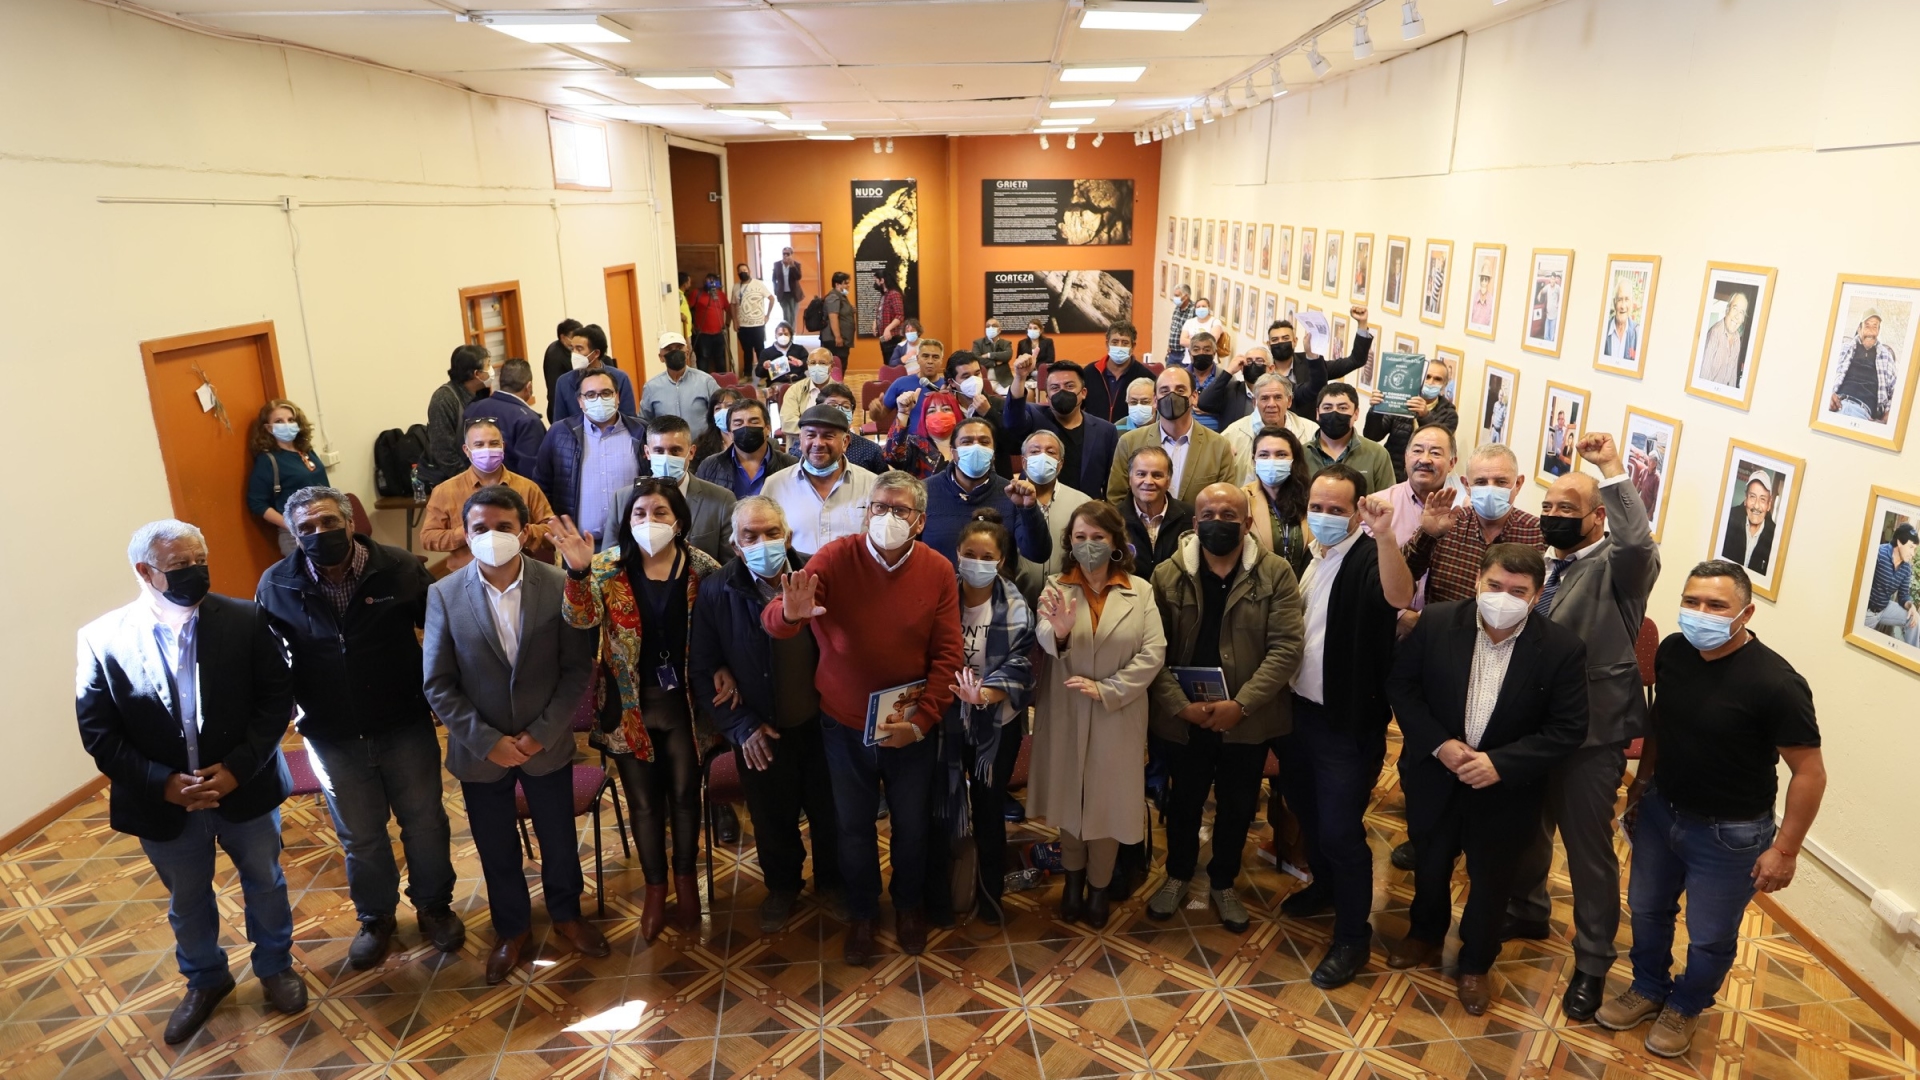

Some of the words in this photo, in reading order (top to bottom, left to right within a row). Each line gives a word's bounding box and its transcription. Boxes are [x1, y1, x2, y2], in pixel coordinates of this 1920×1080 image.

[996, 180, 1028, 189] GRIETA
[855, 187, 883, 197] NUDO
[995, 273, 1034, 283] CORTEZA
